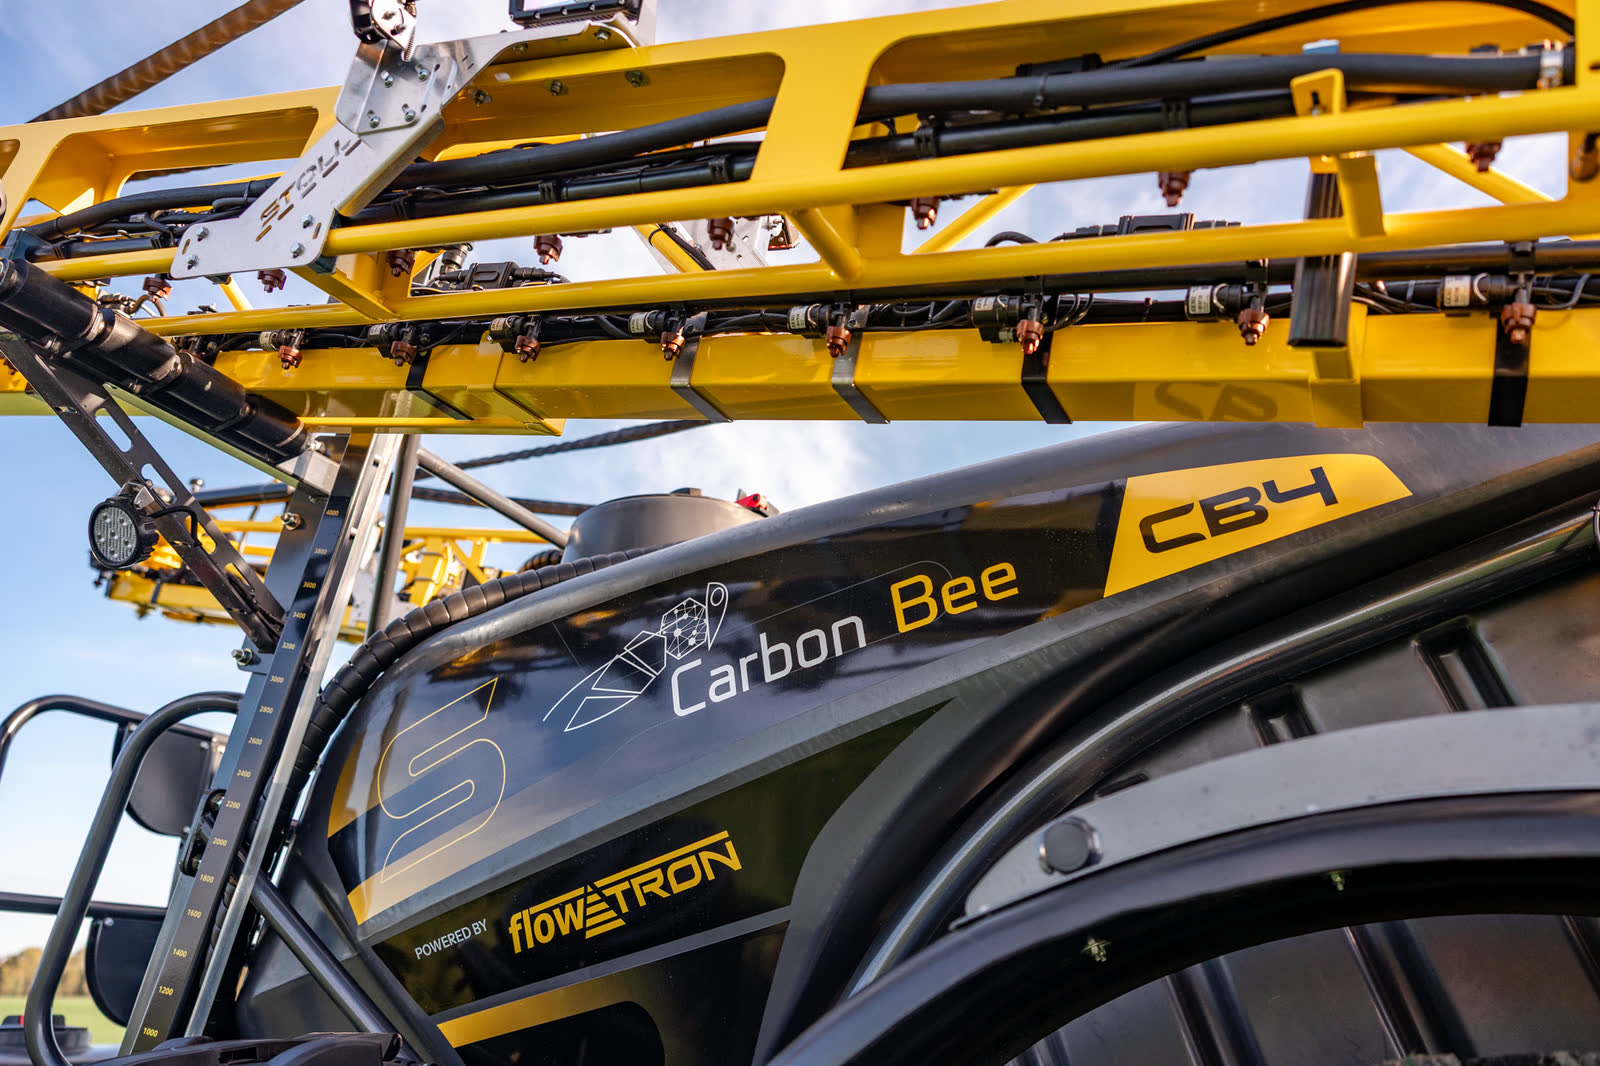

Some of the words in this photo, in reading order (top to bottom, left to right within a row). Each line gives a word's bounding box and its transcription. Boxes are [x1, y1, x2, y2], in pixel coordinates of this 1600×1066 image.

[325, 509, 340, 517] 4000
[1139, 466, 1339, 554] CB4
[302, 581, 317, 589] 3600
[291, 611, 307, 620] 3400
[671, 615, 867, 717] Carbon
[890, 562, 1020, 634] Bee
[281, 642, 296, 651] 3200
[270, 675, 285, 684] 3000
[259, 705, 274, 714] 2800
[248, 736, 263, 746] 2600
[236, 768, 252, 778] 2400
[225, 799, 241, 810] 2200
[212, 836, 228, 847] 2000
[199, 873, 215, 884] 1800
[186, 908, 202, 919] 1600
[414, 926, 472, 960] POWERED
[471, 918, 488, 936] BY
[172, 947, 188, 959] 1400
[158, 985, 174, 996] 1200
[142, 1026, 159, 1038] 1000
